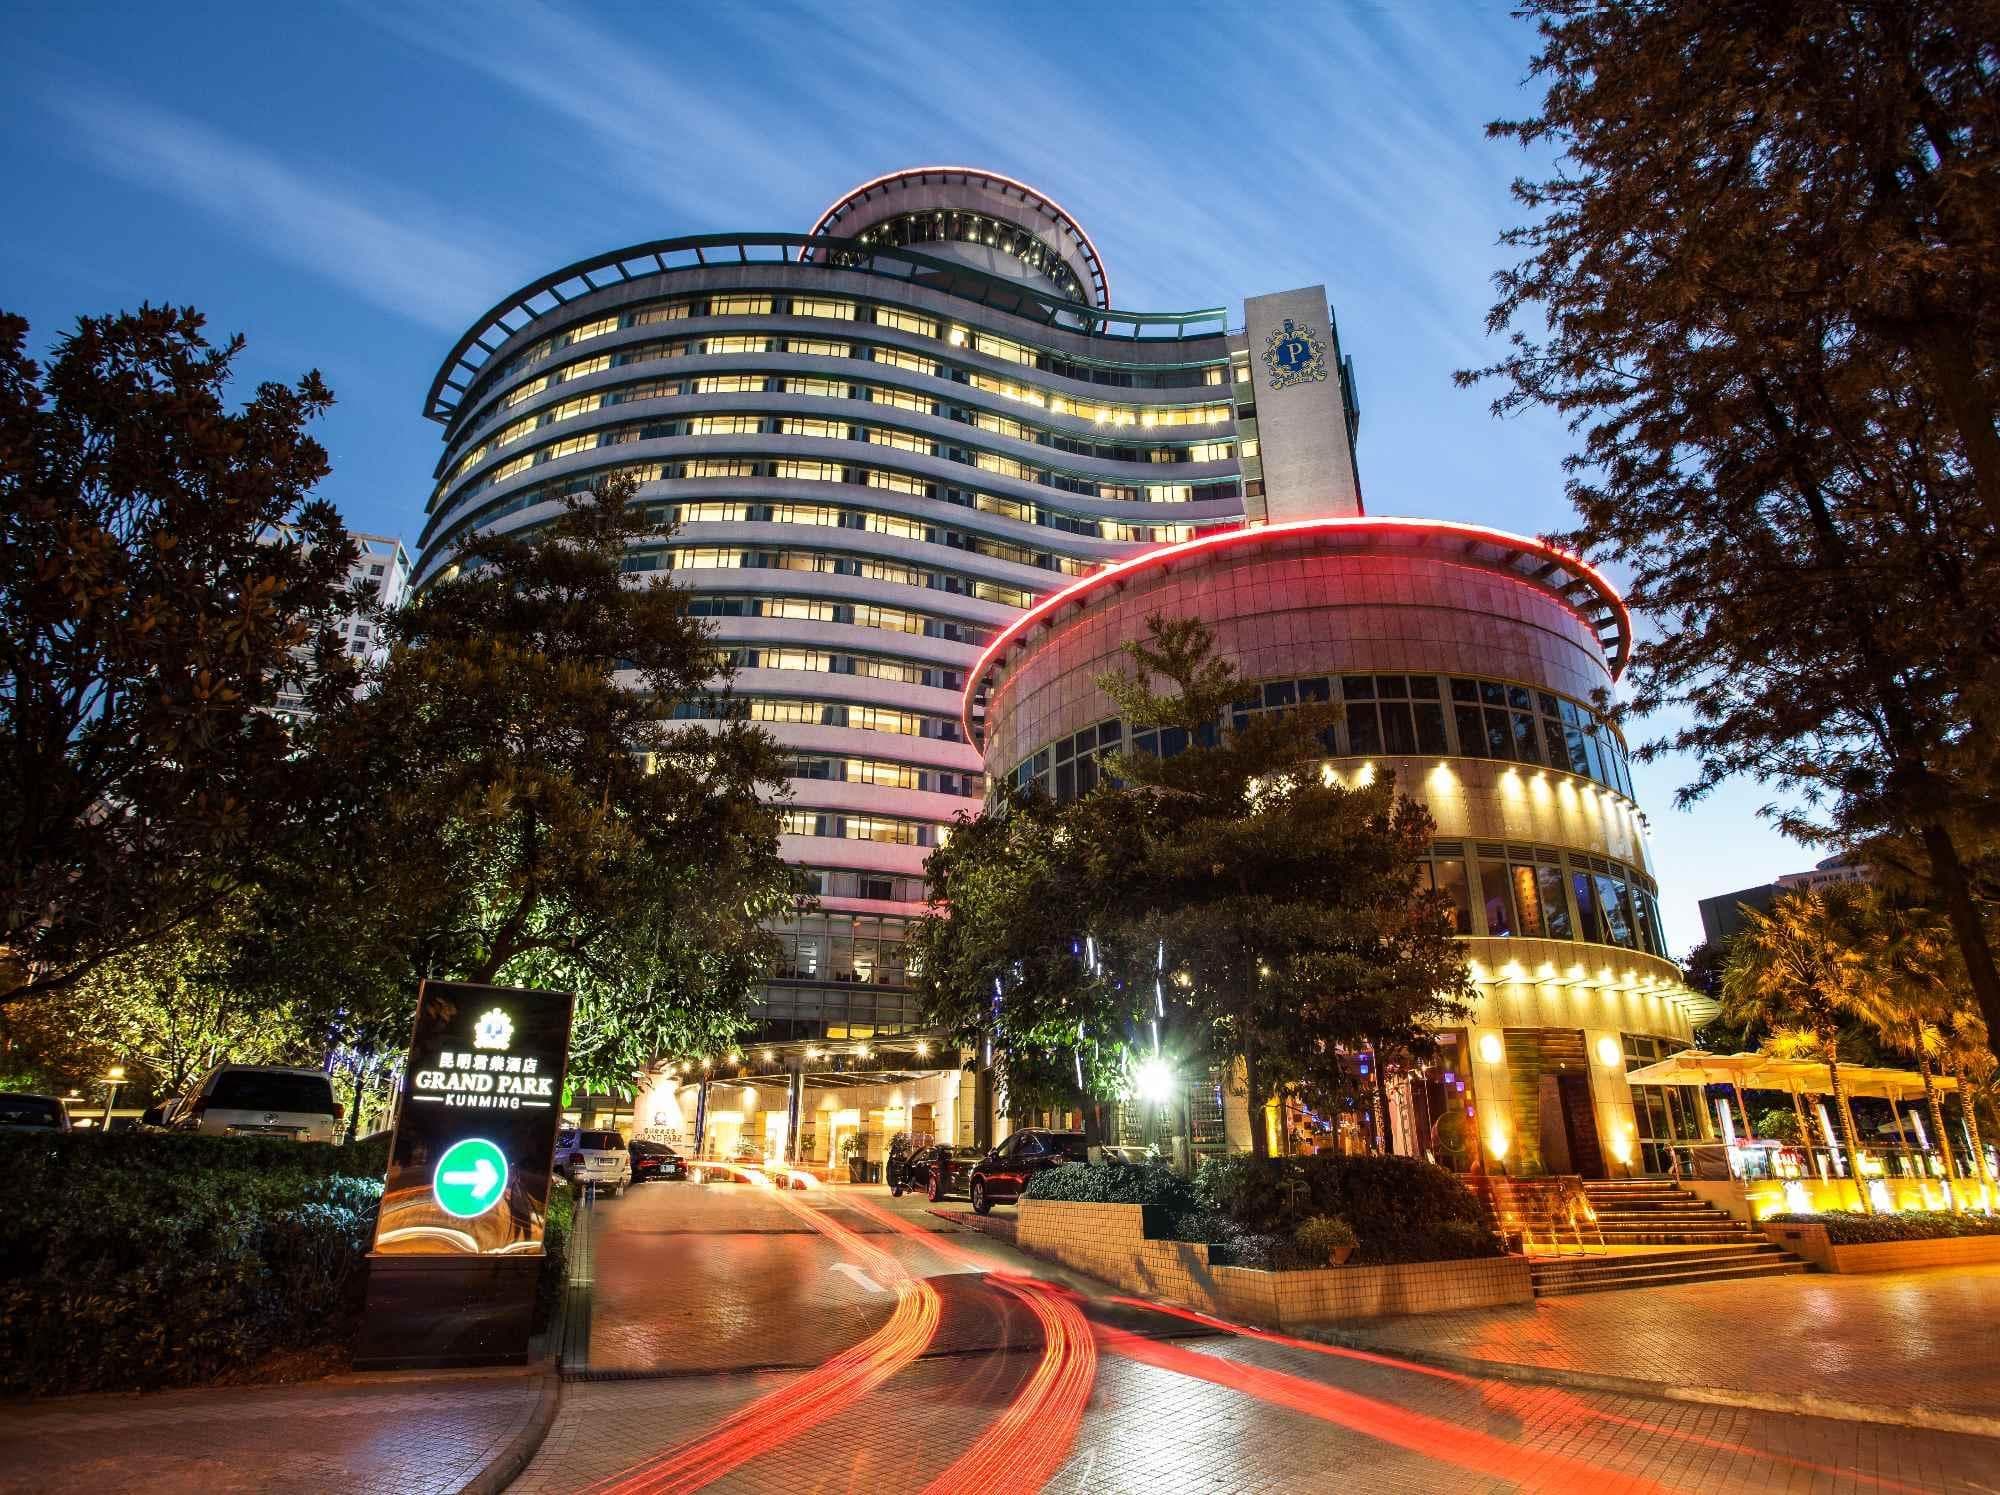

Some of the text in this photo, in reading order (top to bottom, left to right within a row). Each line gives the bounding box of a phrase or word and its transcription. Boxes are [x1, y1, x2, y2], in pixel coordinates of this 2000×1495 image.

[1287, 342, 1303, 364] P
[416, 1070, 553, 1095] GRAND PARK
[445, 1093, 520, 1109] KUNMING
